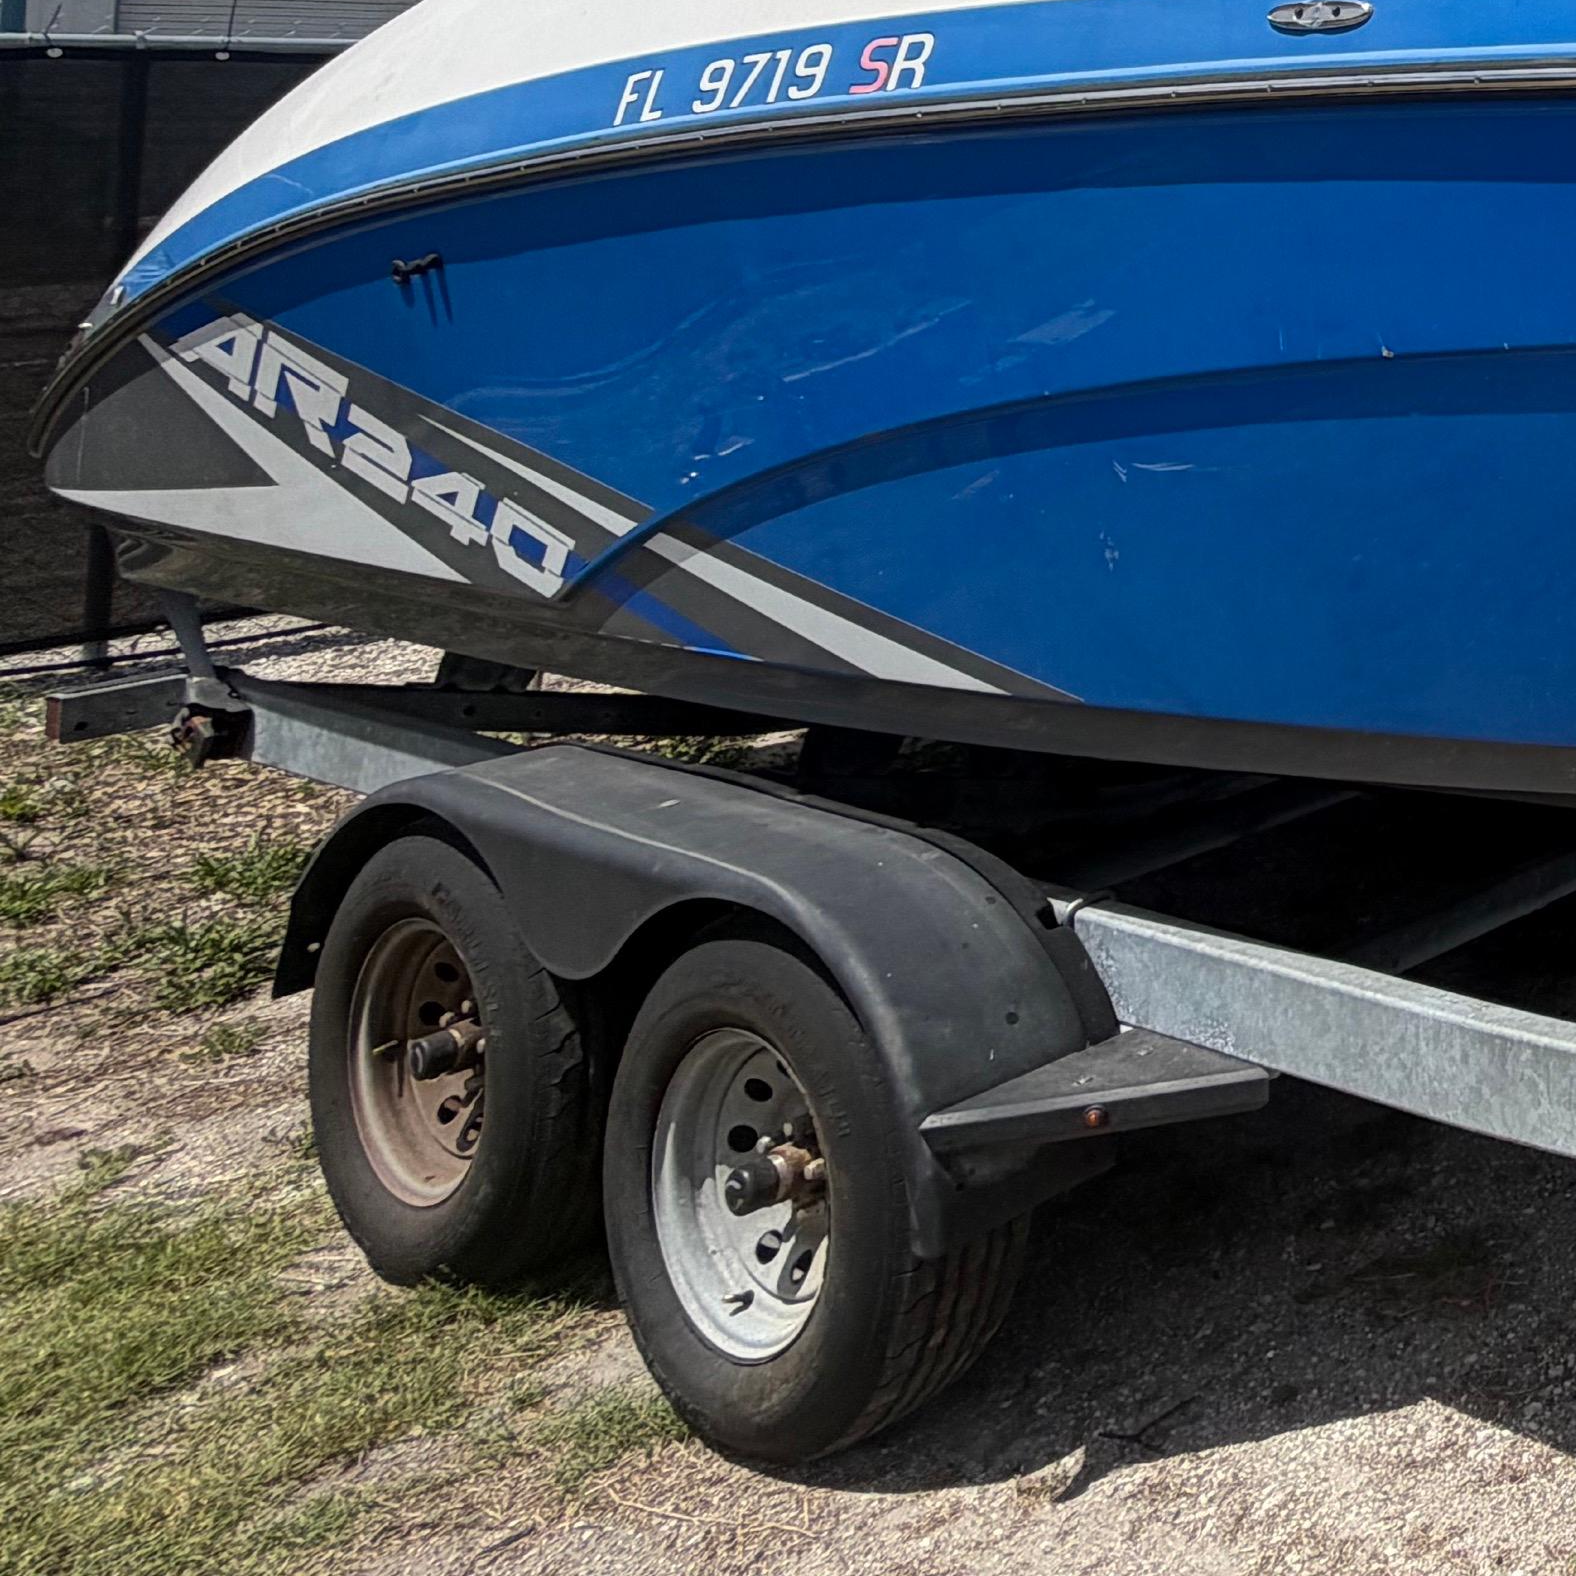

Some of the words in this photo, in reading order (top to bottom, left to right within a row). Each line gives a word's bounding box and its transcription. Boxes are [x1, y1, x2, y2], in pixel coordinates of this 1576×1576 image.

[612, 70, 664, 126] FL
[692, 43, 833, 114] 9719
[848, 33, 935, 94] SR
[169, 312, 577, 599] AR240
